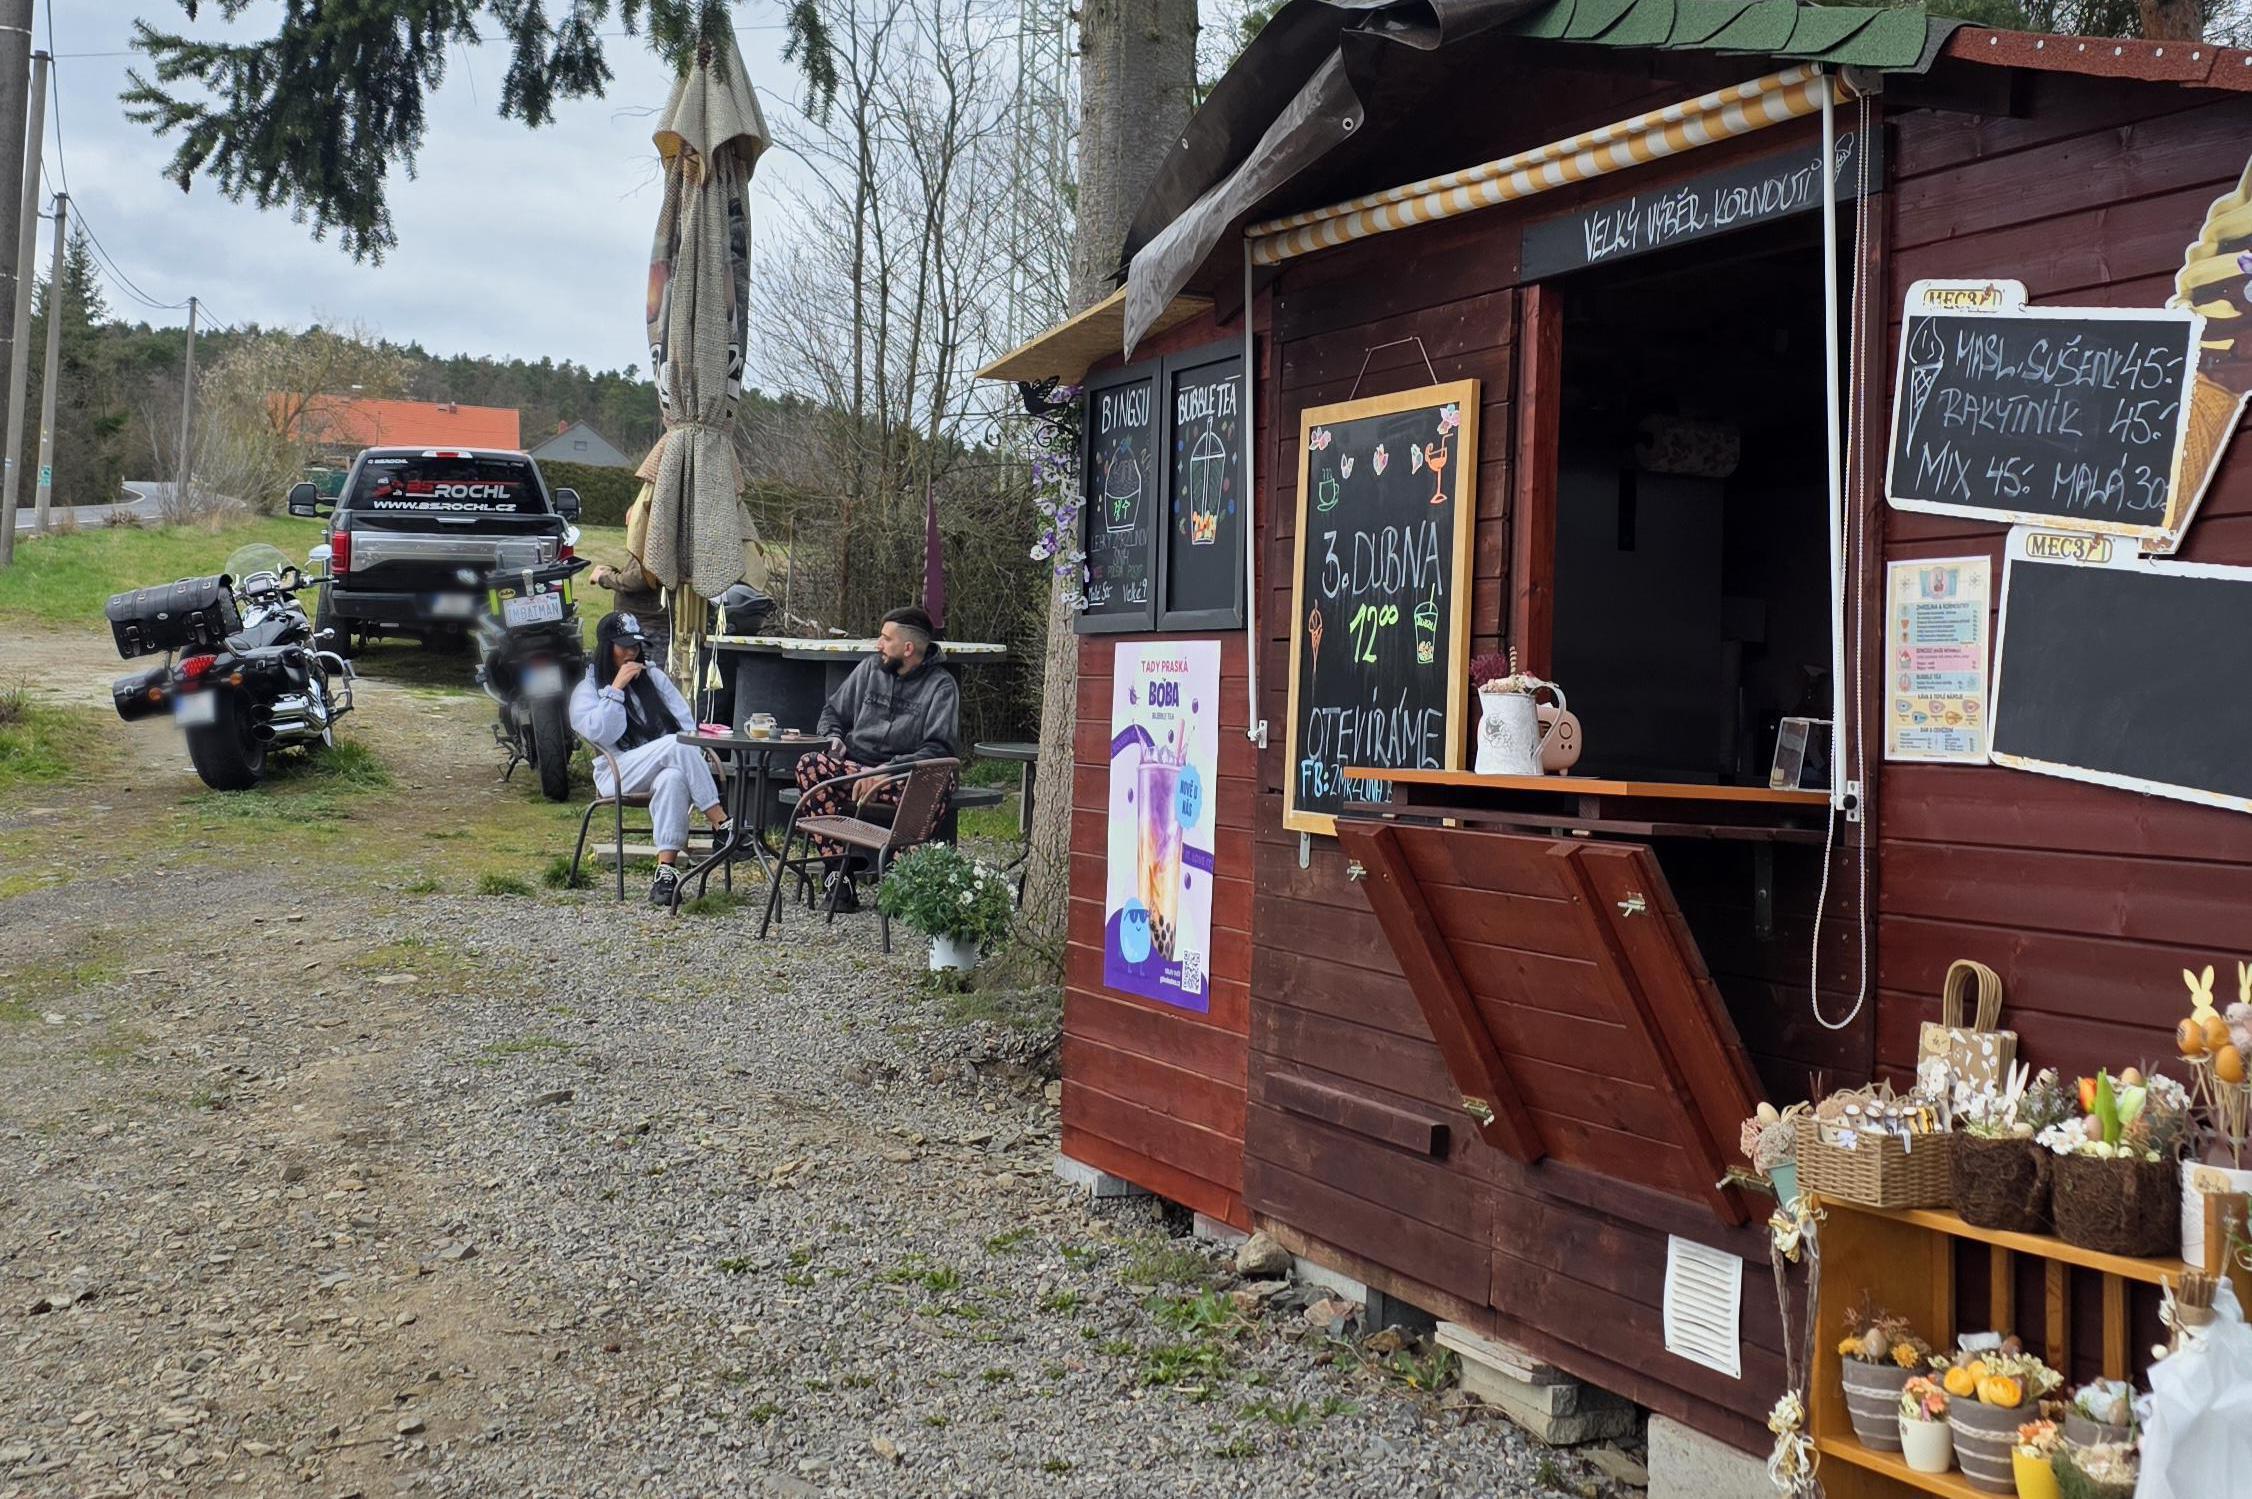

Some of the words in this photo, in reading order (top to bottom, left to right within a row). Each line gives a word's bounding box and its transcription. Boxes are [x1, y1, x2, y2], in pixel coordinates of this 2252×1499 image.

[1584, 196, 1640, 263] VELKÝ
[1647, 186, 1708, 246] VÝBĚR
[1101, 386, 1151, 435] BINGSU
[1178, 384, 1217, 426] BUBBLE
[1216, 382, 1237, 418] TEA
[1939, 387, 2083, 437] RAKYTNÍK
[1915, 440, 1972, 500] MIX
[2051, 452, 2128, 513] MALÁ
[1352, 520, 1443, 596] DUBNA
[2031, 535, 2085, 558] MEC3
[1141, 660, 1160, 673] TADY
[1161, 656, 1189, 673] PRASKÁ
[1149, 681, 1179, 708] BOBA
[1307, 687, 1443, 770] OTEVÍRÁME
[1301, 759, 1329, 798] FB:
